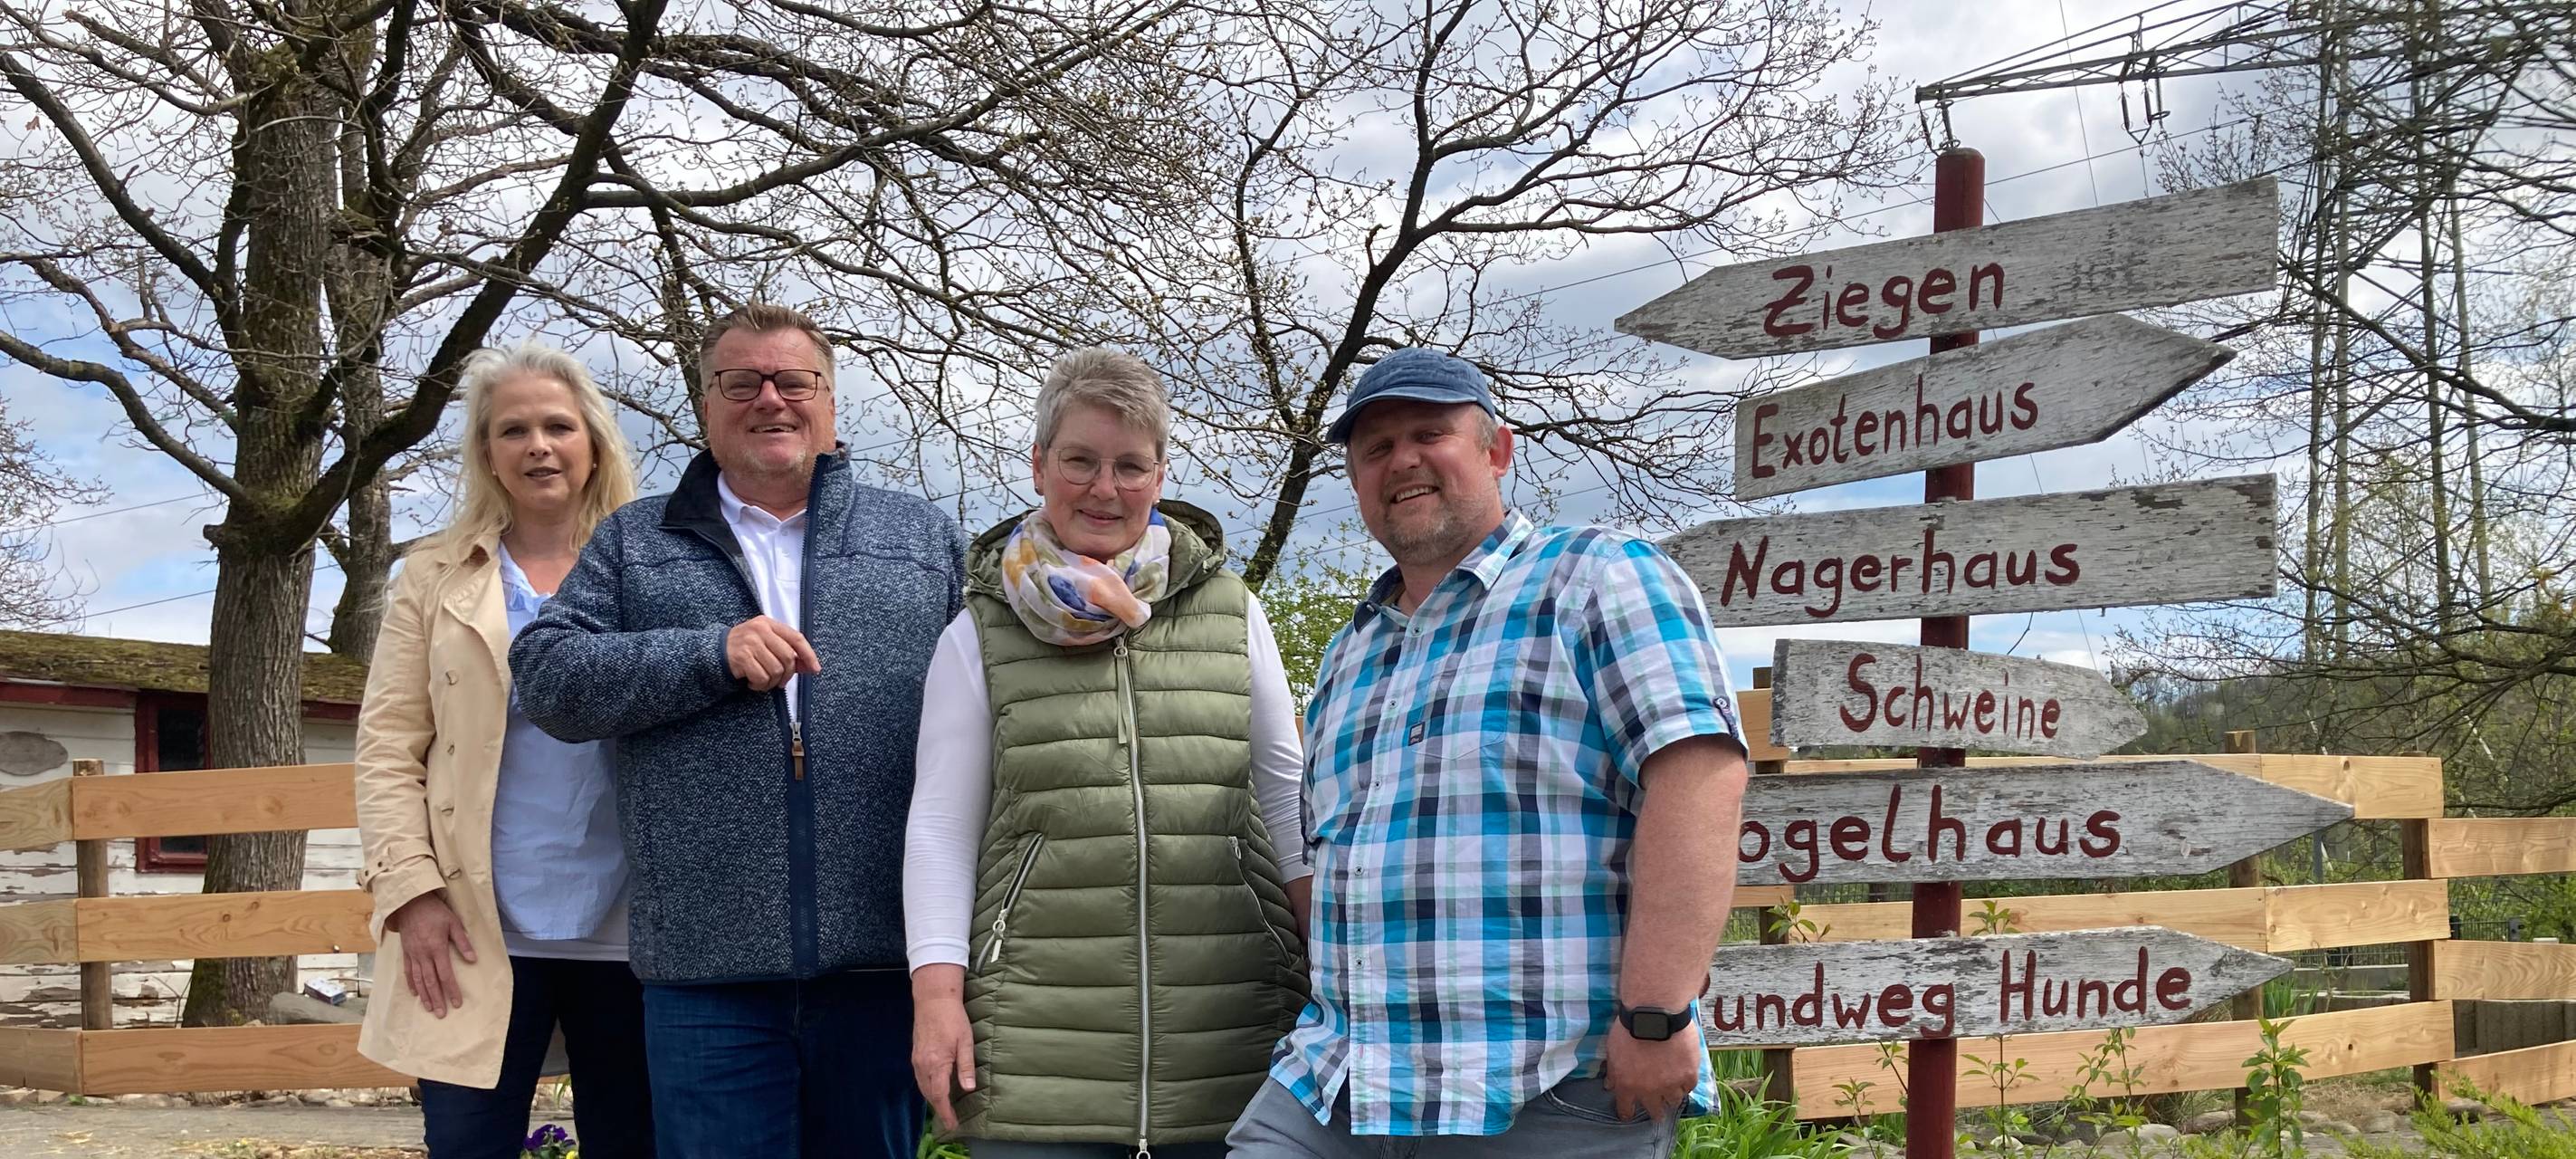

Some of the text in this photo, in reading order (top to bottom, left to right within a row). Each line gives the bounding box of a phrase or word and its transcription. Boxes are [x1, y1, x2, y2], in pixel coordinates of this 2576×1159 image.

[1763, 263, 2006, 340] Ziegen
[1751, 373, 2039, 479] Exotenhaus
[1721, 526, 2081, 618] Nagerhaus
[1839, 652, 2062, 740] Schweine
[1739, 784, 2122, 882] ogelhaus
[1698, 945, 2193, 1038] undweg Hunde
